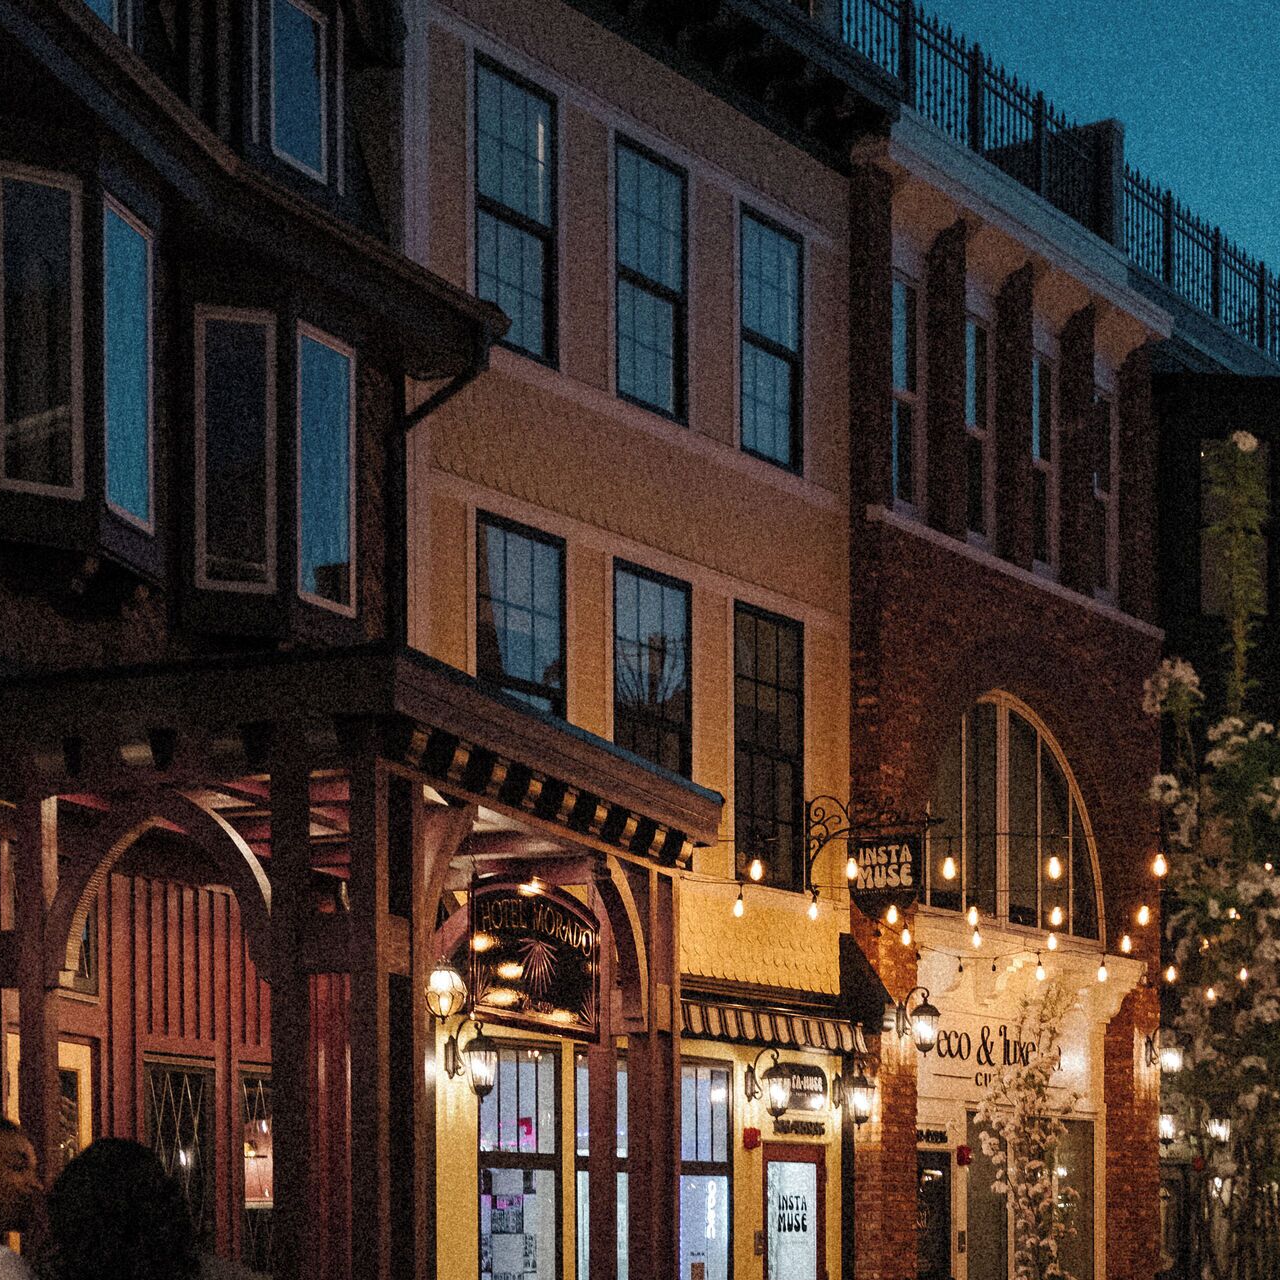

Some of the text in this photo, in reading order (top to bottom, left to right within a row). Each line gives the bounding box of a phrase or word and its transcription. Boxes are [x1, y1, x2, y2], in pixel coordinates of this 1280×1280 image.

[858, 844, 913, 867] INSTA
[856, 863, 913, 889] MUSE
[482, 899, 593, 957] HOTEL MORADO
[976, 1026, 996, 1067] &
[778, 1194, 808, 1211] INSTA
[778, 1213, 808, 1233] MUSE
